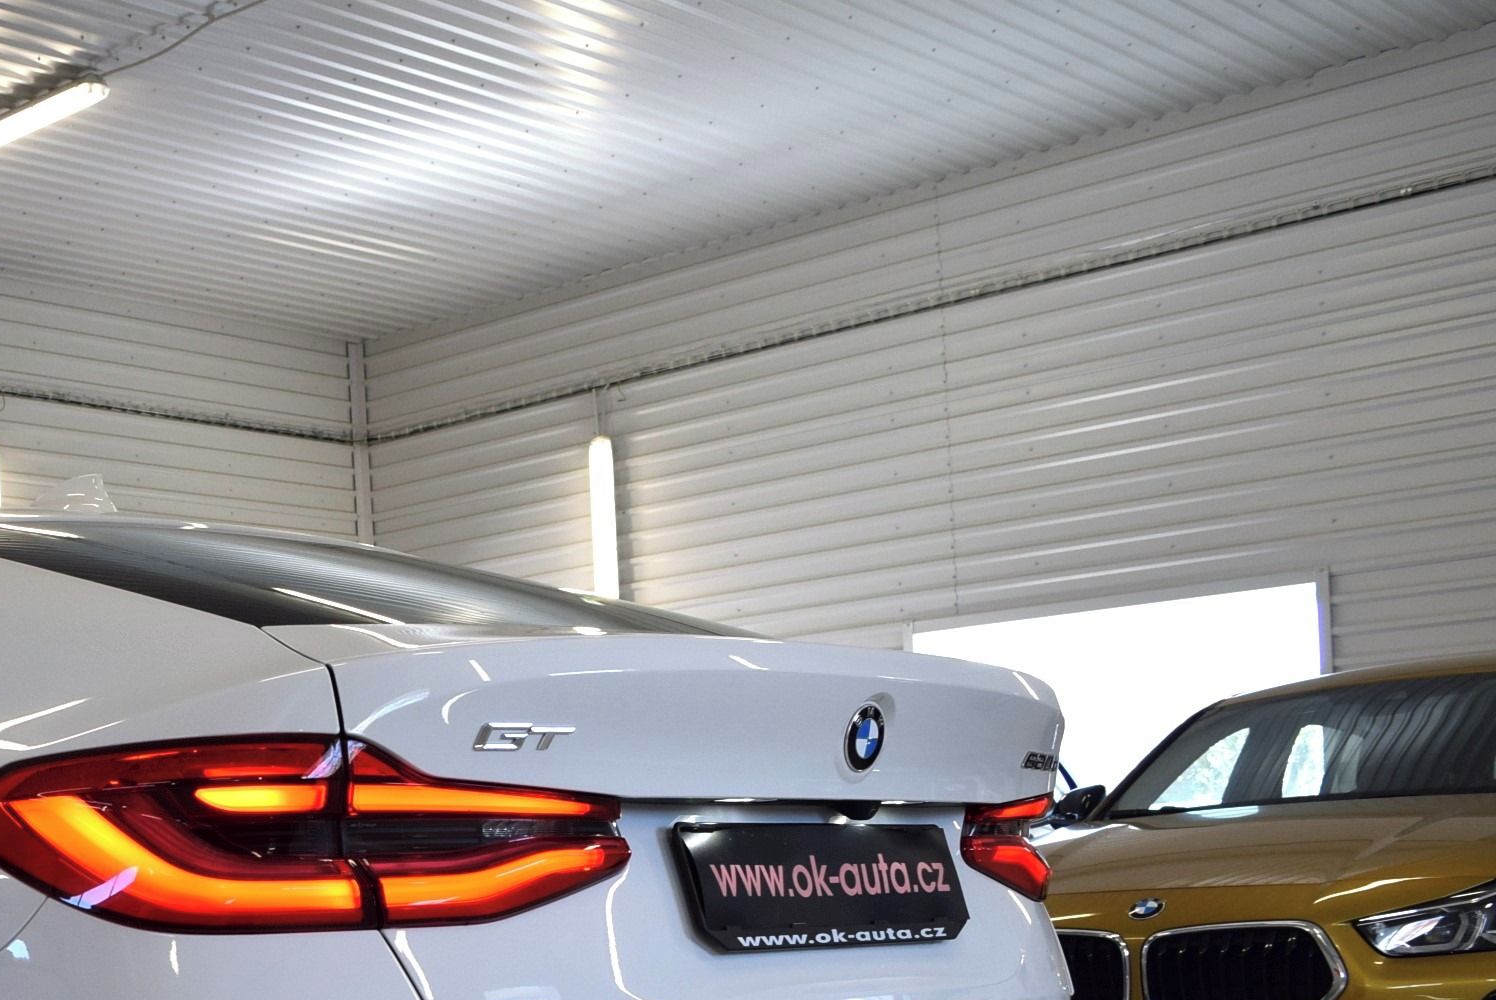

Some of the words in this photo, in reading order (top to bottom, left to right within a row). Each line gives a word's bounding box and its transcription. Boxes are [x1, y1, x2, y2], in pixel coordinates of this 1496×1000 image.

[472, 722, 576, 751] GT
[710, 853, 951, 898] www.ok-auta.cz
[737, 926, 947, 947] www.ok-auta.cz
